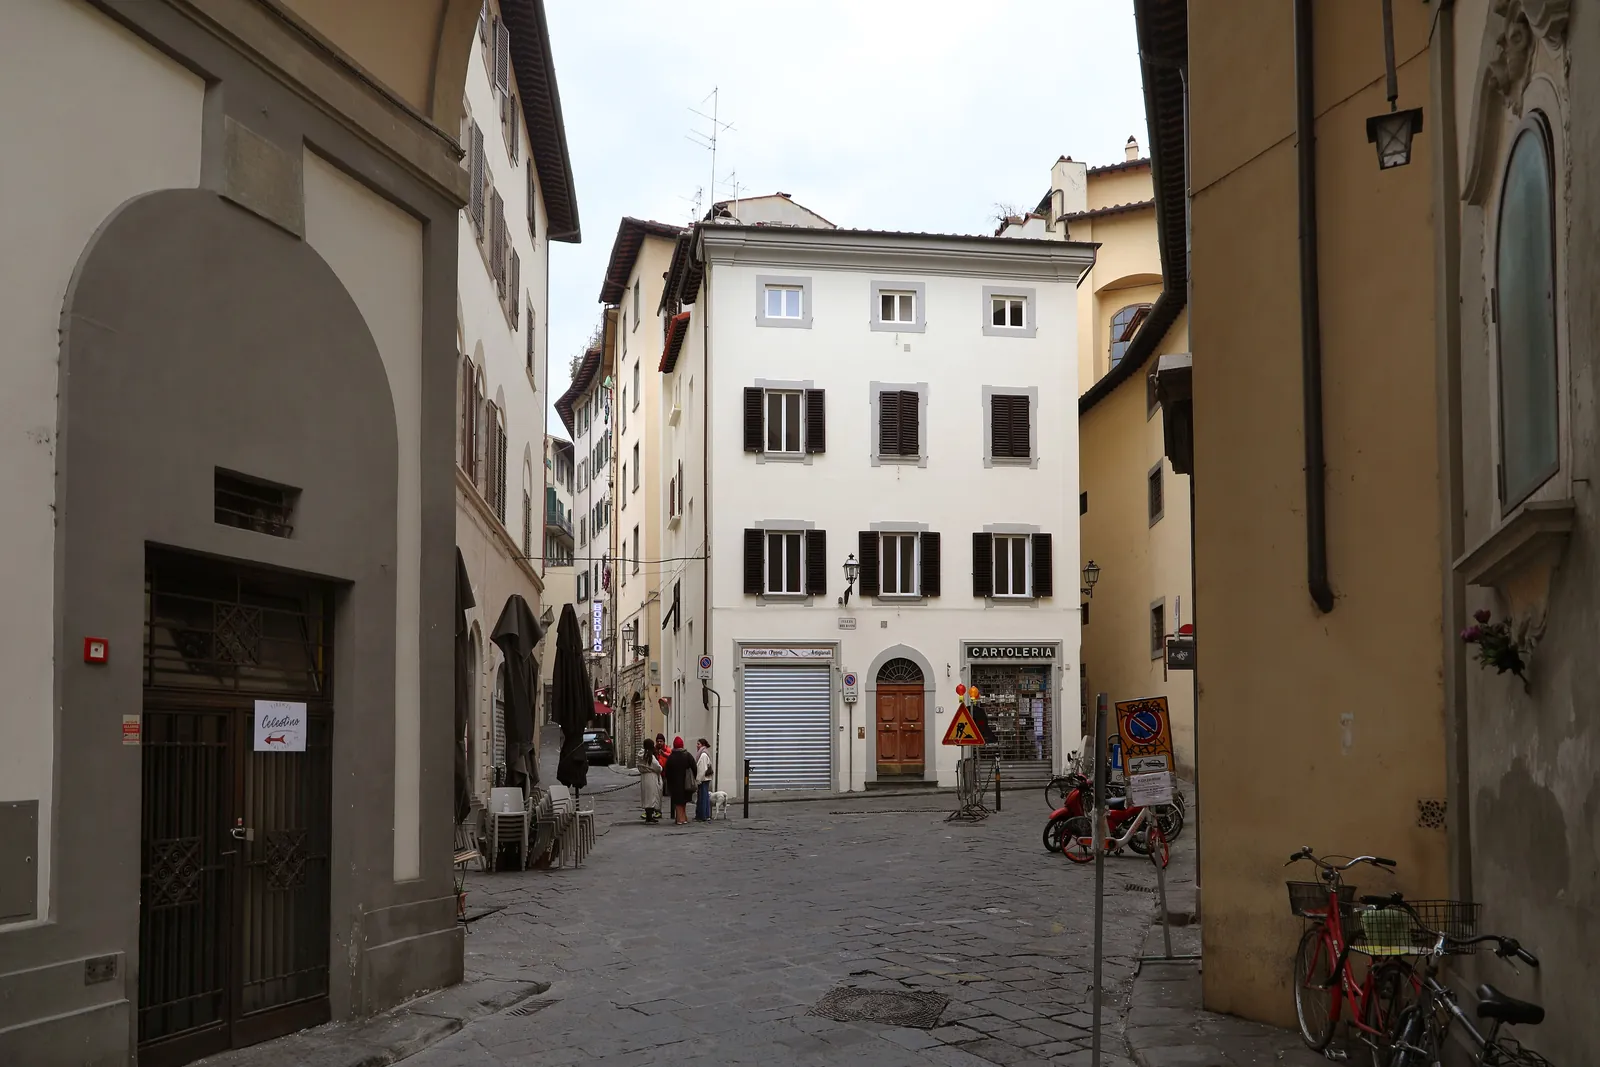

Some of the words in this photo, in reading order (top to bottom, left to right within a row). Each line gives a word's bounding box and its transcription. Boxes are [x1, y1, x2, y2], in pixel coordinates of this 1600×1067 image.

[594, 603, 602, 651] BORDINO
[972, 647, 1052, 657] CARTOLERIA
[261, 715, 300, 728] Celestino
